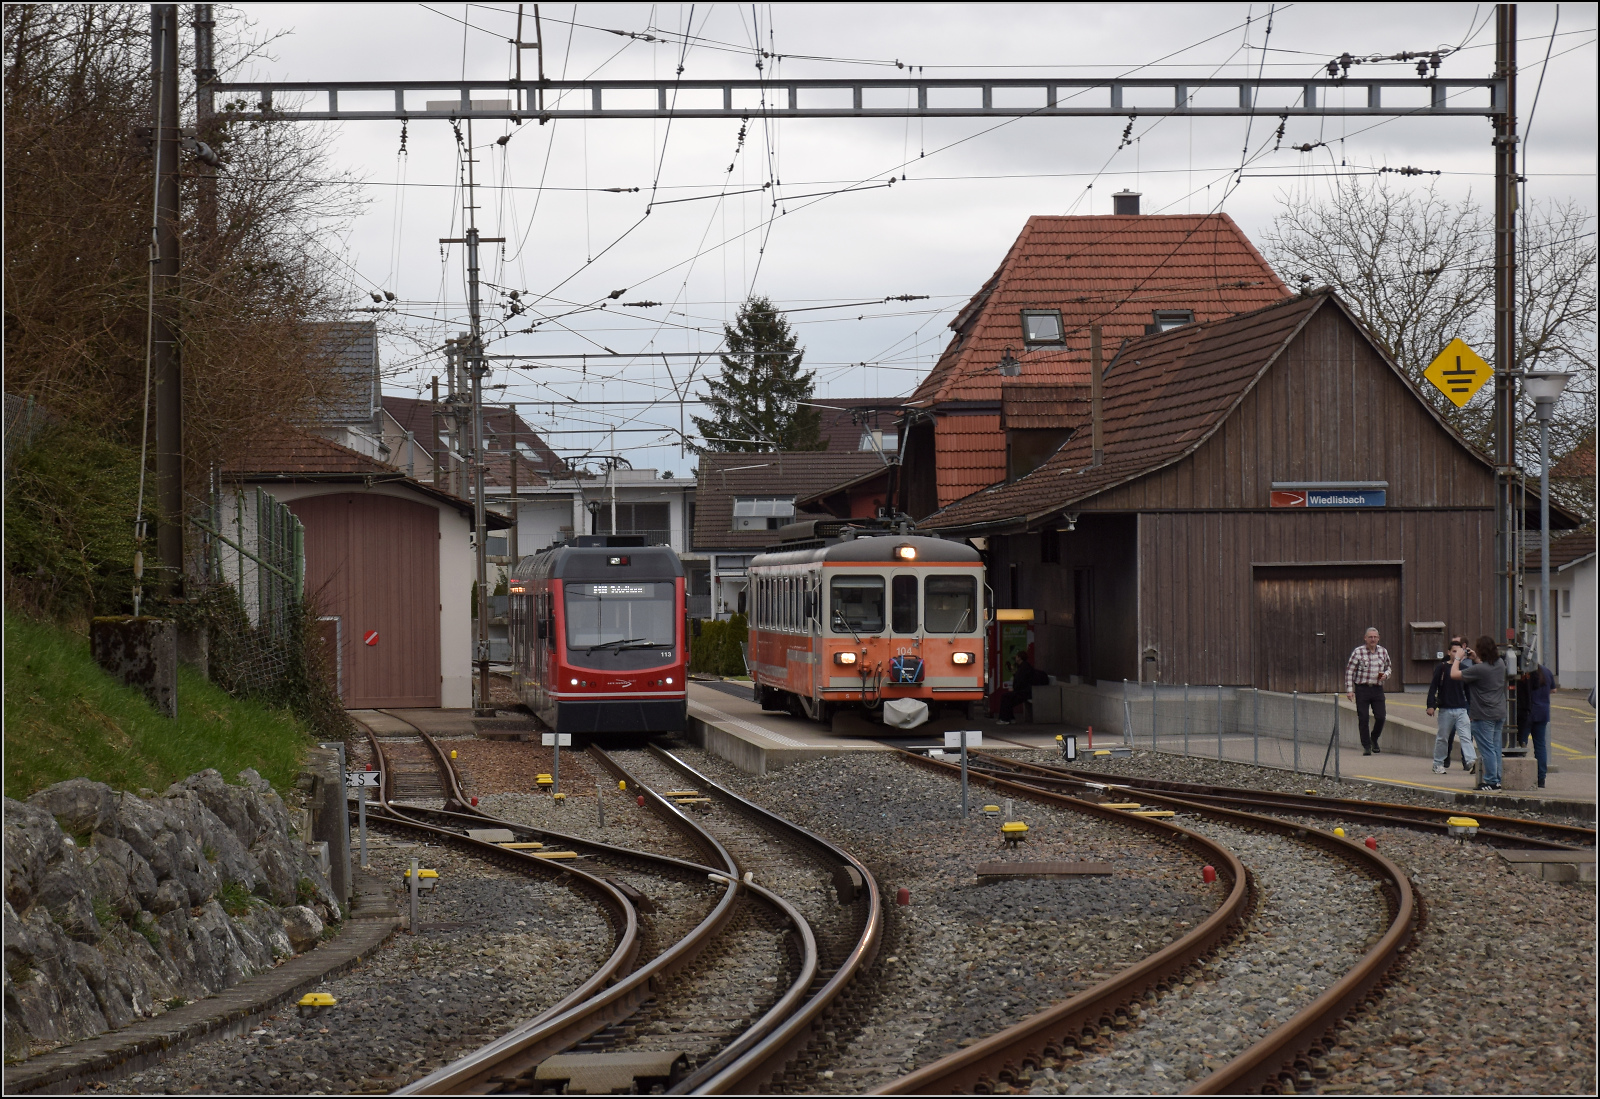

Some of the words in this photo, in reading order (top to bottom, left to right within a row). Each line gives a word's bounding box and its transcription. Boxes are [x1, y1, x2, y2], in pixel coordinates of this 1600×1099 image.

[1309, 495, 1365, 504] Wiedlisbach
[896, 646, 912, 656] 104
[358, 773, 365, 785] S
